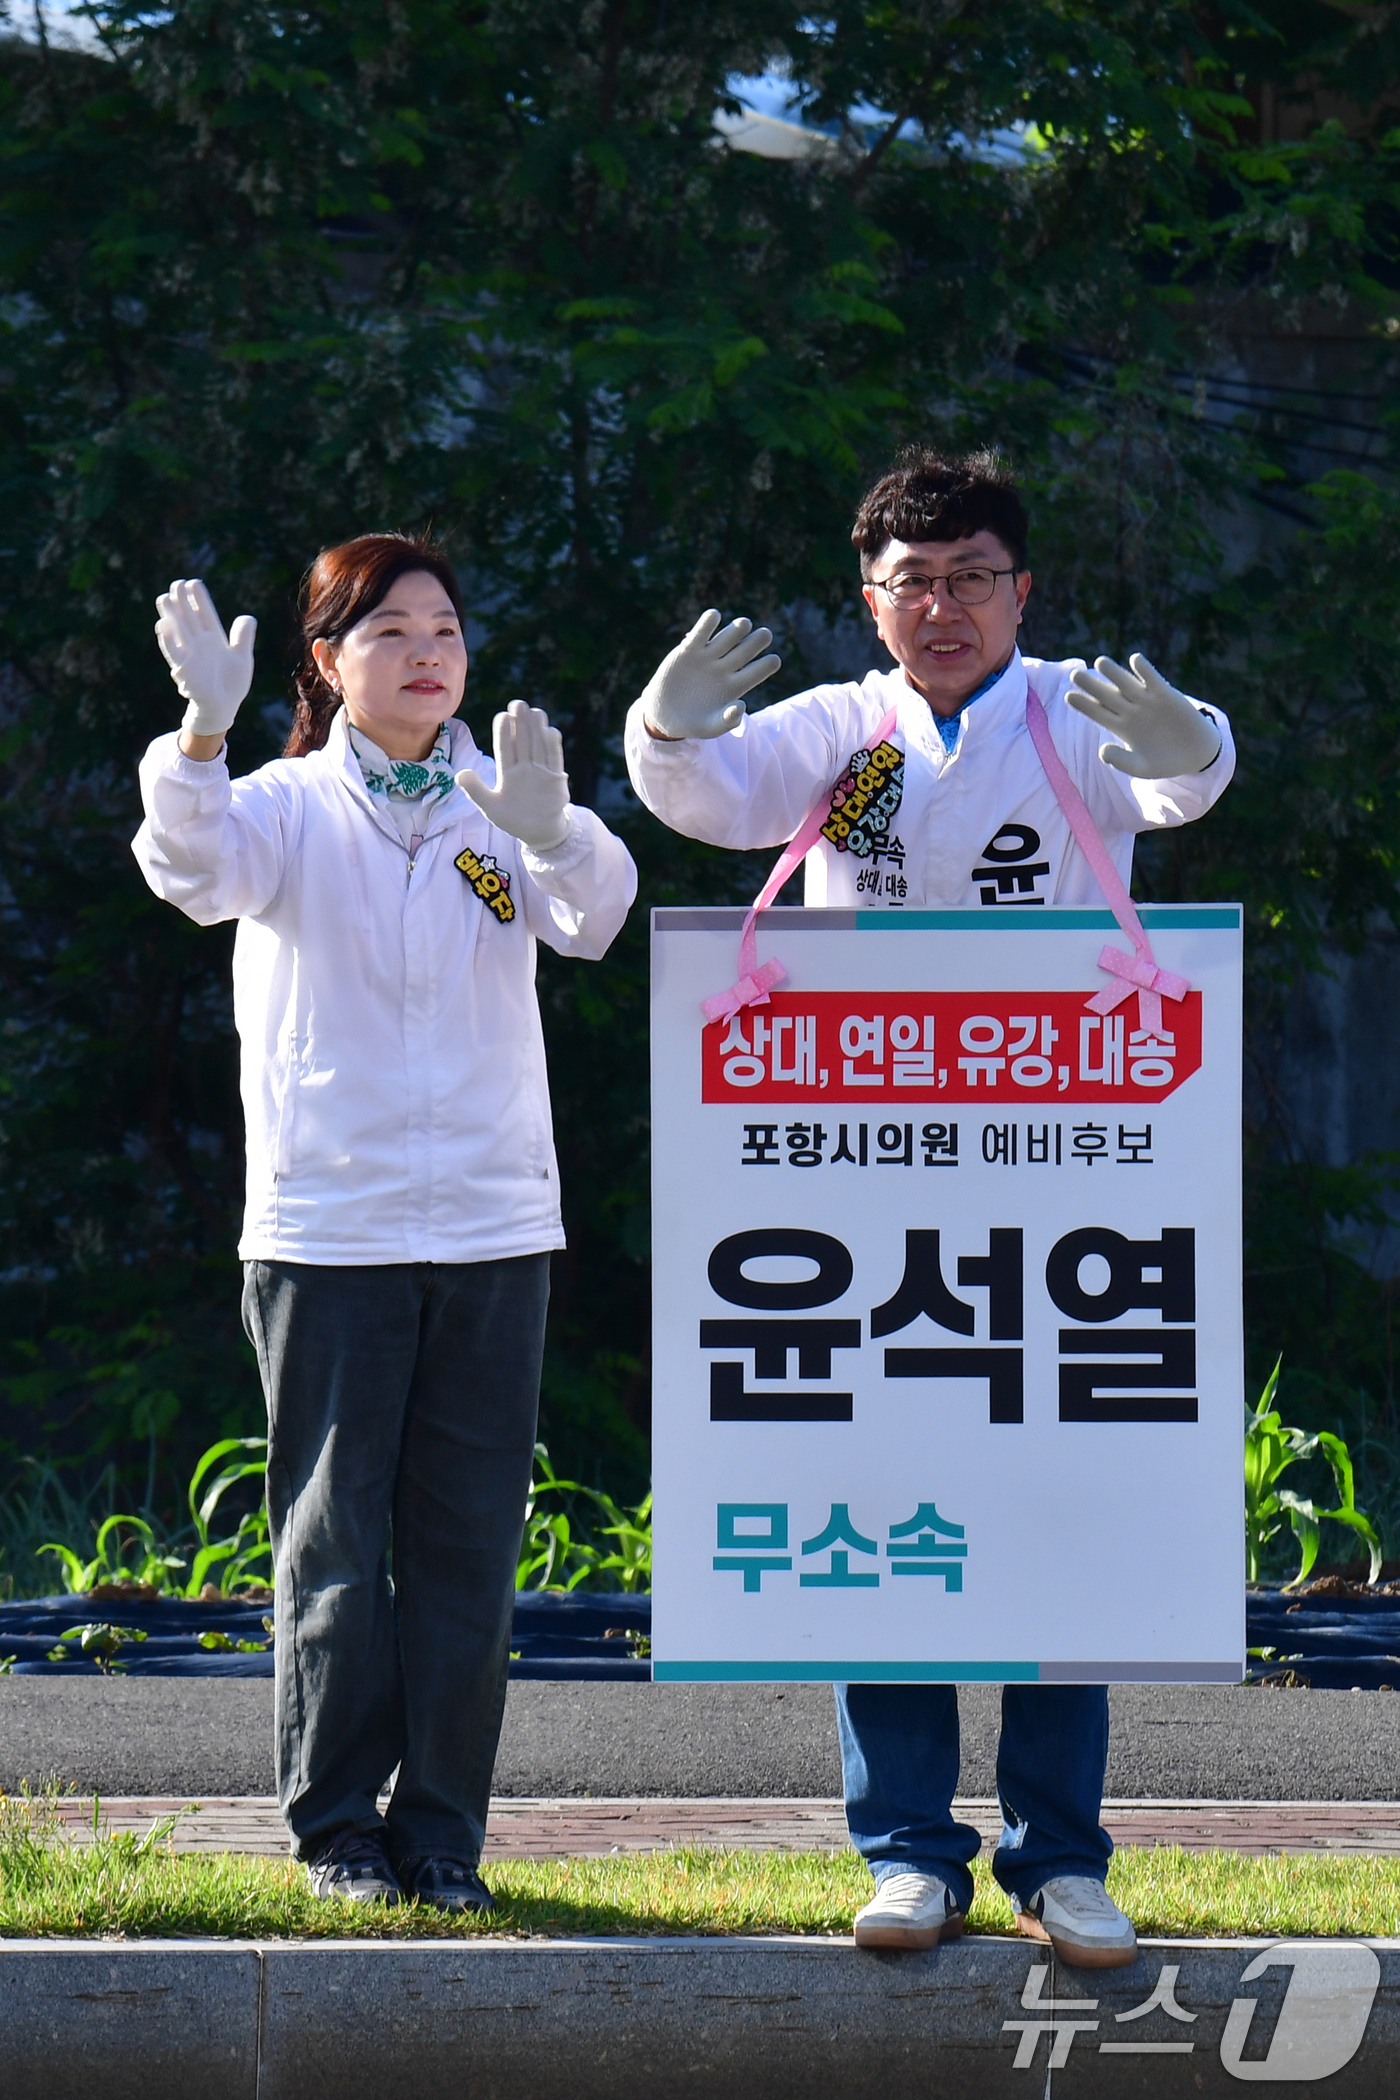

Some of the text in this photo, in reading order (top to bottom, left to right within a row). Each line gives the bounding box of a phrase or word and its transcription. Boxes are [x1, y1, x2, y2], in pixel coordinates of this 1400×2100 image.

[455, 849, 515, 921] 배우자
[971, 823, 1050, 906] 윤
[719, 1014, 1176, 1092] 상대, 연일, 유강, 대송
[741, 1122, 1155, 1167] 포항시의원 예비후보
[699, 1226, 1199, 1425] 윤석열
[712, 1502, 968, 1593] 무소속
